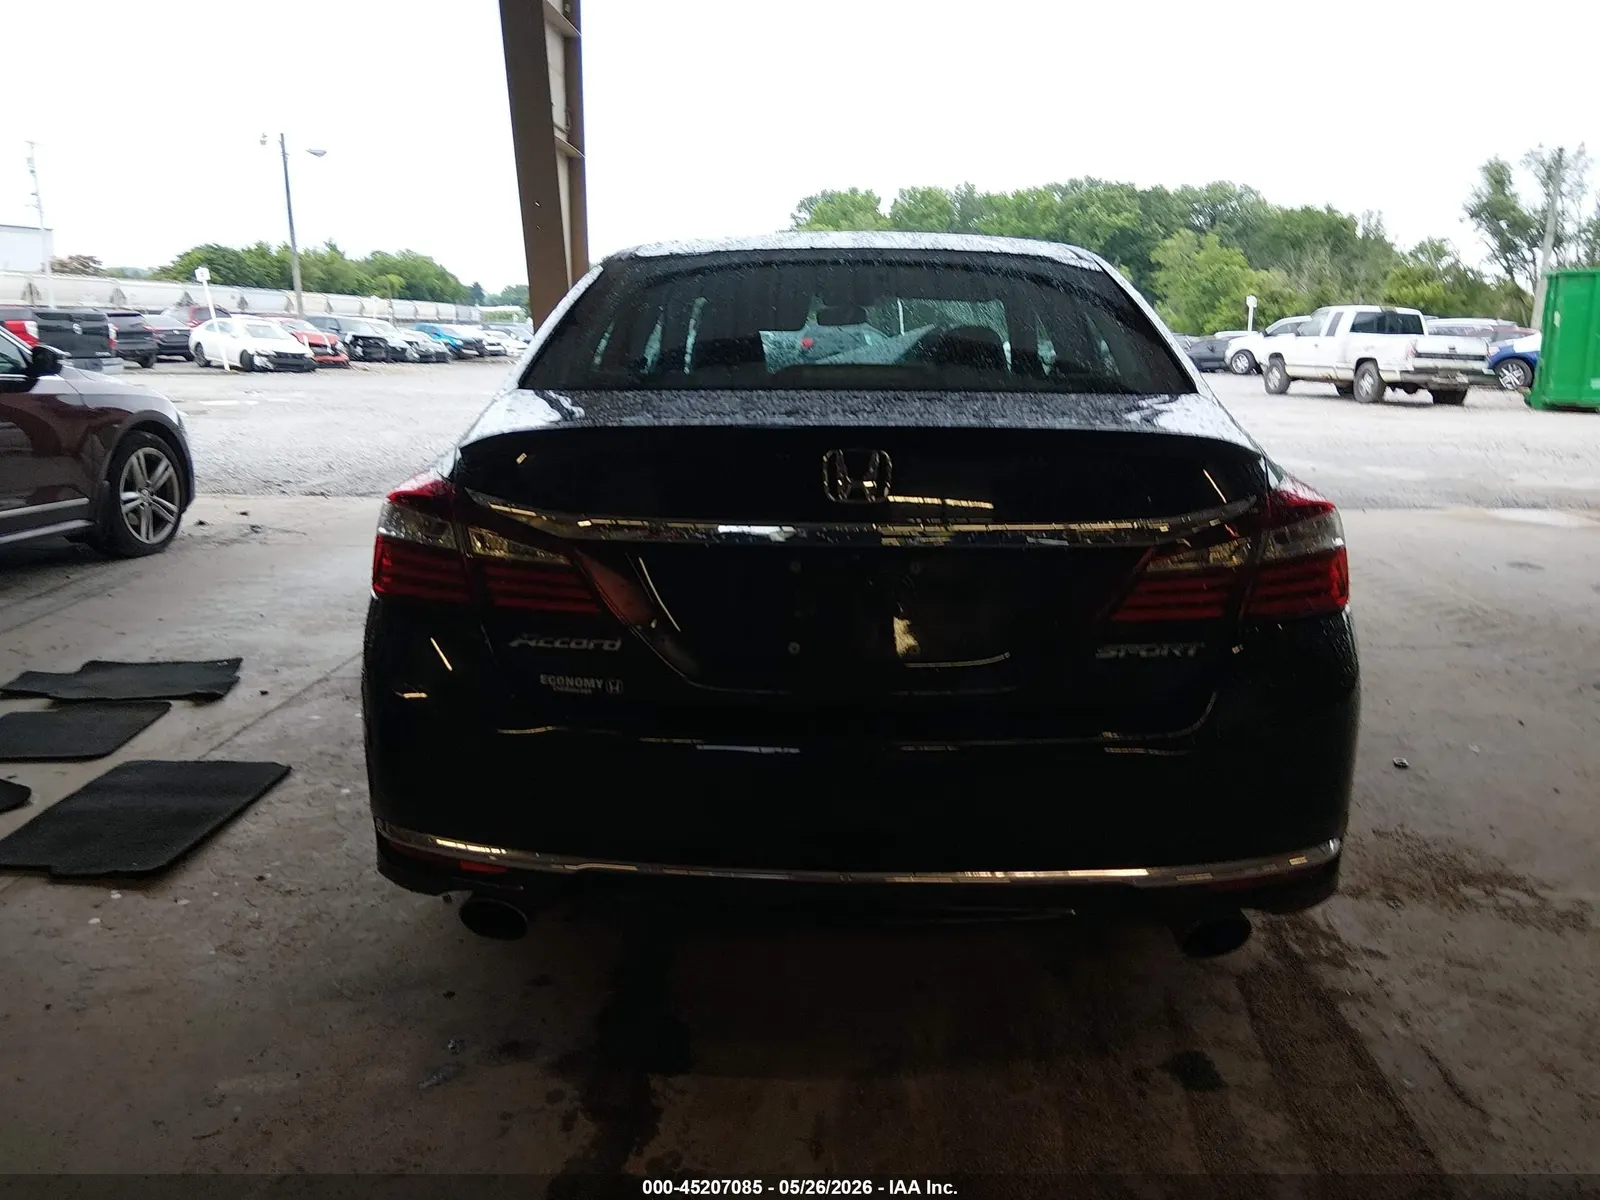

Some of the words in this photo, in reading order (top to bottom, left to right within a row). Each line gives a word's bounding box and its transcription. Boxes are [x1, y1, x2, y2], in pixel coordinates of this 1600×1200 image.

[508, 632, 622, 652] Accord
[1095, 641, 1205, 659] SPORT
[539, 673, 604, 690] ECONOMY
